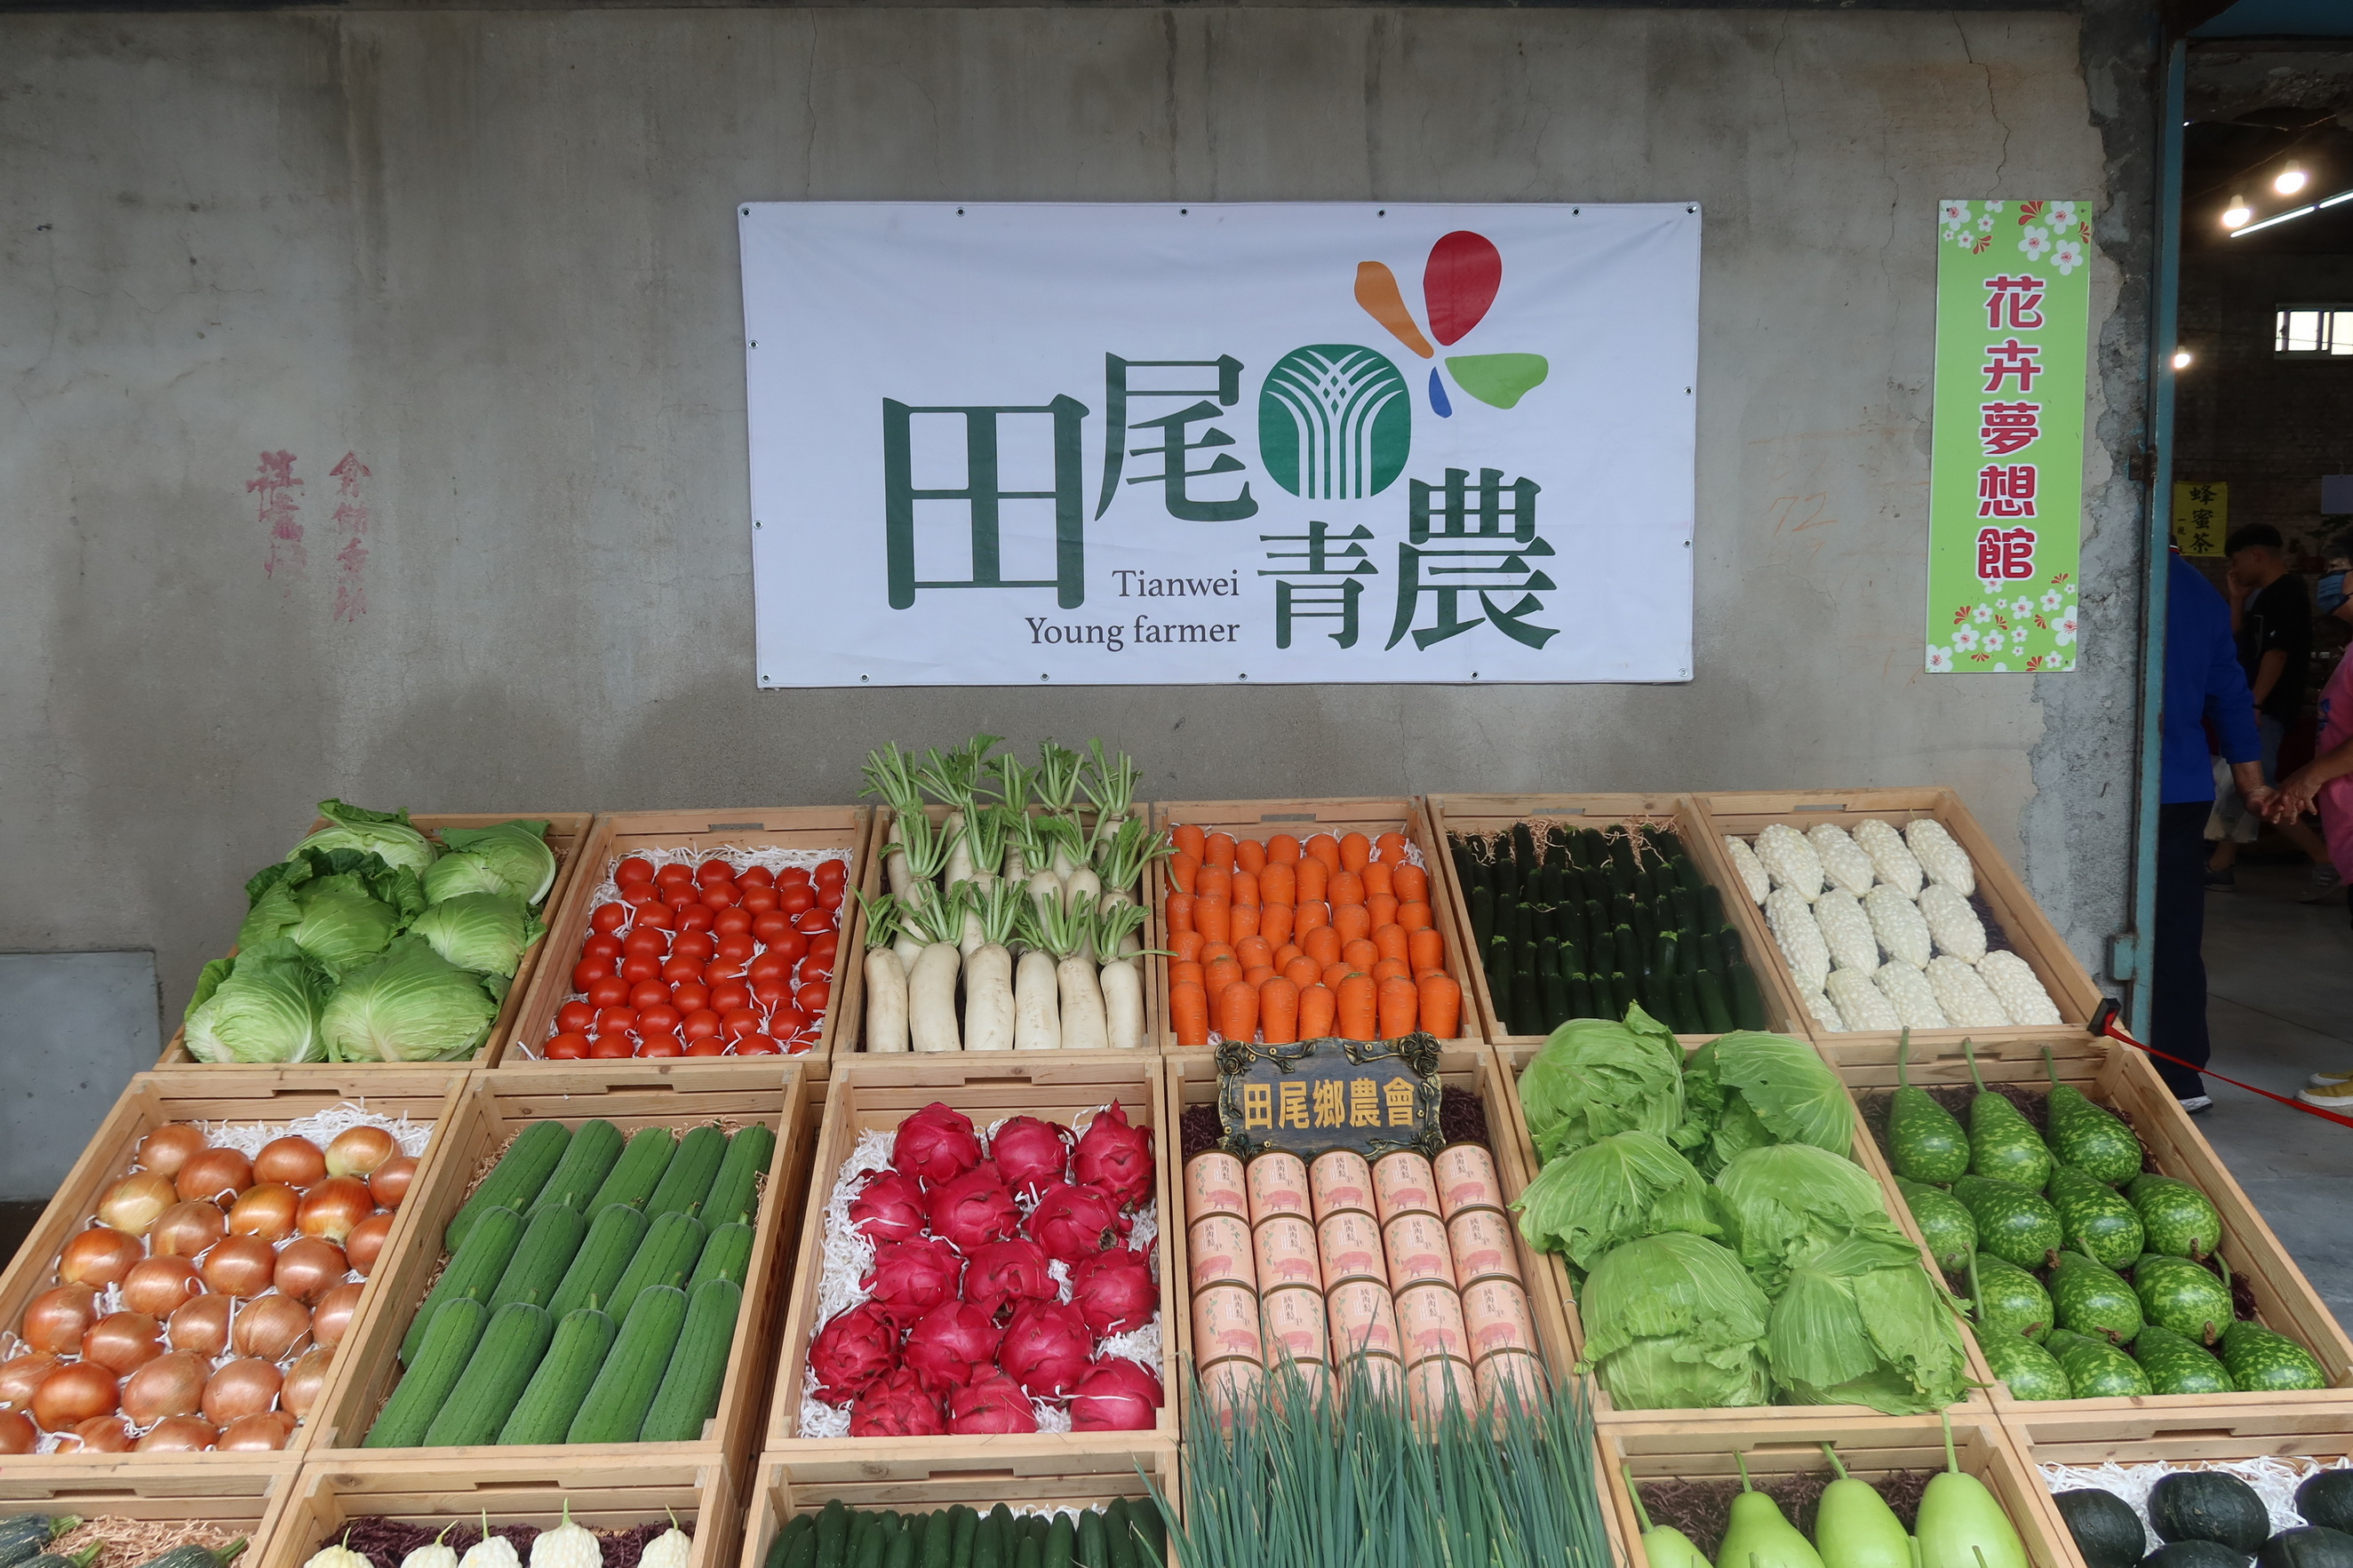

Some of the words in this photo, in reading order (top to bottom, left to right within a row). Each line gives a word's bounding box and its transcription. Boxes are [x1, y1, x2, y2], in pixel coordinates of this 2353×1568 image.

[1977, 275, 2045, 580] 花卉夢想館
[1767, 490, 1839, 537] 72
[2189, 485, 2217, 553] 蜂蜜茶
[1112, 569, 1240, 597] Tianwei
[1025, 617, 1124, 652] Young
[1133, 615, 1240, 643] farmer
[1244, 1076, 1416, 1130] 田尾鄉農會
